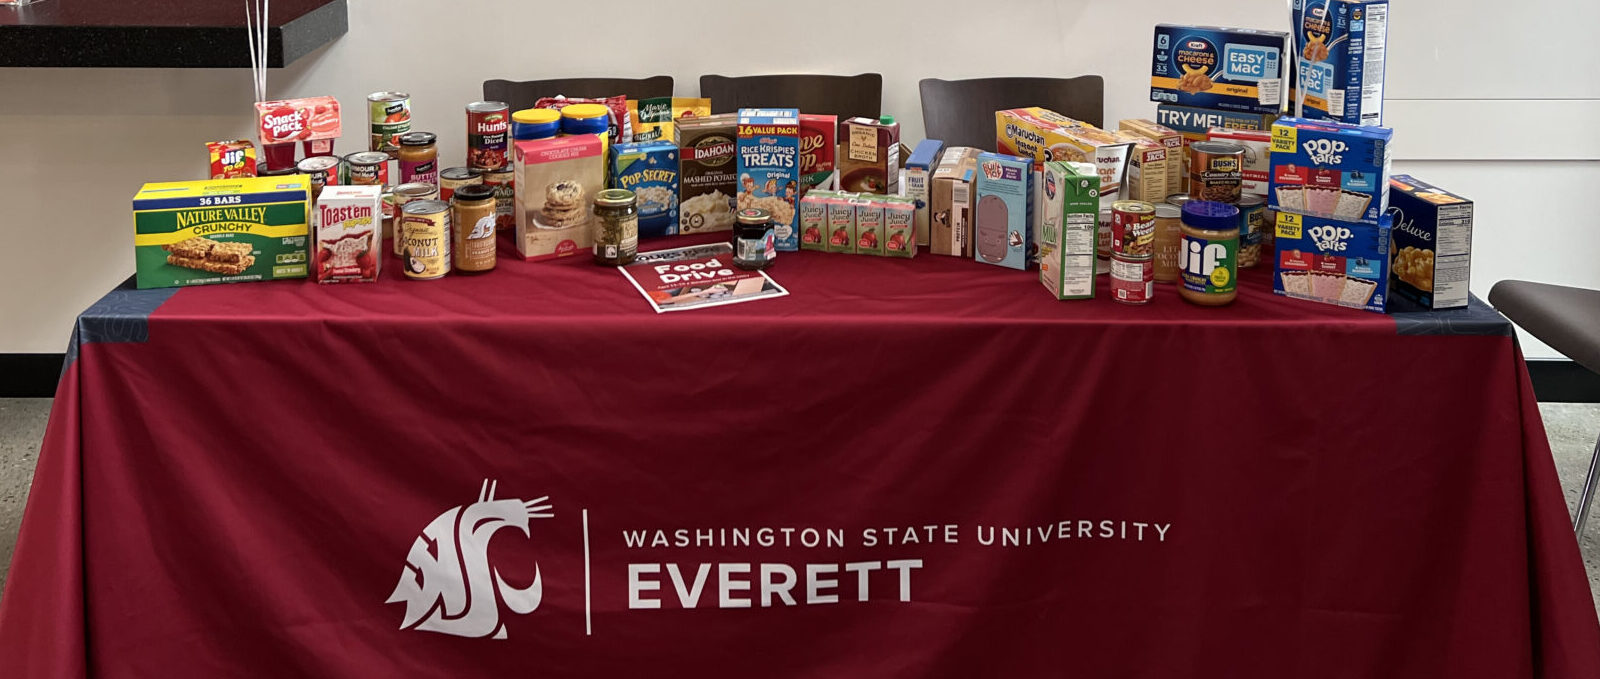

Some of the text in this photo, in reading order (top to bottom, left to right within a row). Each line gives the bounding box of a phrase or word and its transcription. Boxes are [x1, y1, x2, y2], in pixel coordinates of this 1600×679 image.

[1160, 36, 1166, 44] 6
[264, 111, 303, 129] Snack
[1158, 110, 1191, 126] TRY
[1193, 113, 1222, 128] ME!
[272, 122, 302, 137] pack
[738, 126, 753, 135] 16
[1012, 125, 1045, 145] Maruchan
[695, 144, 734, 159] IDAHOAN
[741, 145, 795, 154] RICE KRISPIES
[221, 150, 244, 165] Jif
[743, 153, 794, 167] TREATS
[1213, 159, 1236, 168] BUSH'S
[214, 196, 241, 204] BARS
[176, 206, 266, 229] NATURE VALLEY
[803, 206, 824, 214] Juicy
[830, 208, 852, 216] Juicy
[859, 211, 881, 219] Juicy
[888, 212, 911, 221] Juicy
[193, 223, 252, 235] CRUNCHY
[1388, 206, 1432, 241] Deluxe
[411, 246, 438, 257] MILK
[1178, 239, 1227, 276] Jif
[654, 258, 722, 274] Food
[659, 268, 734, 284] Drive
[622, 520, 1171, 548] WASHINGTON STATE UNIVERSITY
[628, 559, 923, 609] EVERETT
